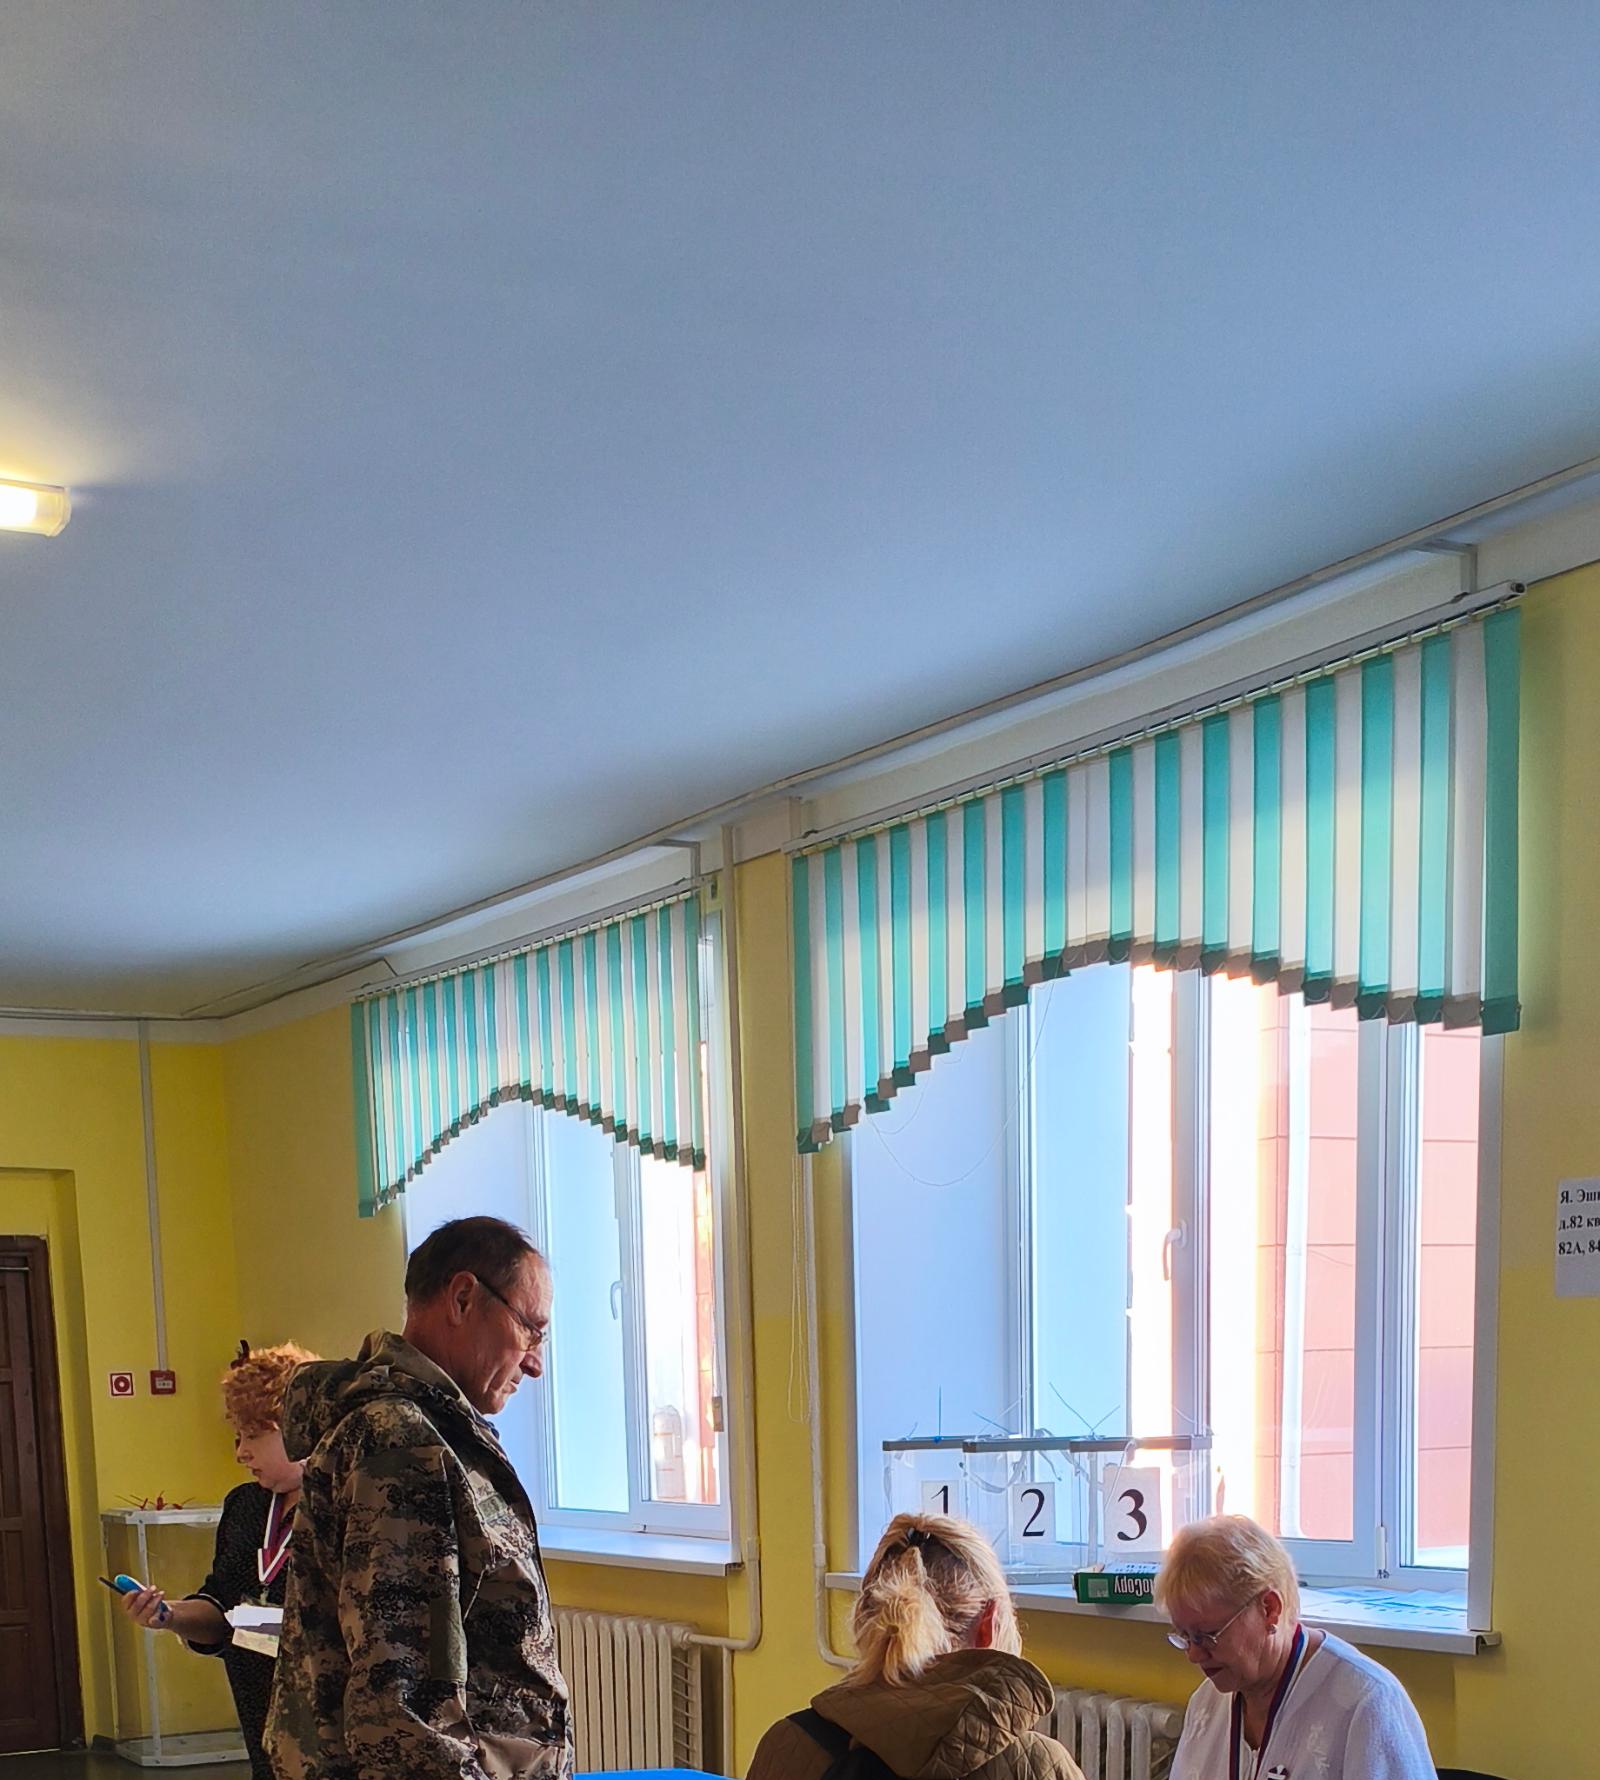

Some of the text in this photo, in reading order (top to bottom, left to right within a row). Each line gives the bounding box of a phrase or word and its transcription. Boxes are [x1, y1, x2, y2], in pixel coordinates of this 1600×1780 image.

[1560, 1190, 1573, 1204] Я.
[1558, 1214, 1583, 1231] д.82
[931, 1485, 949, 1514] 1
[1020, 1488, 1046, 1537] 2
[1116, 1488, 1148, 1542] 3
